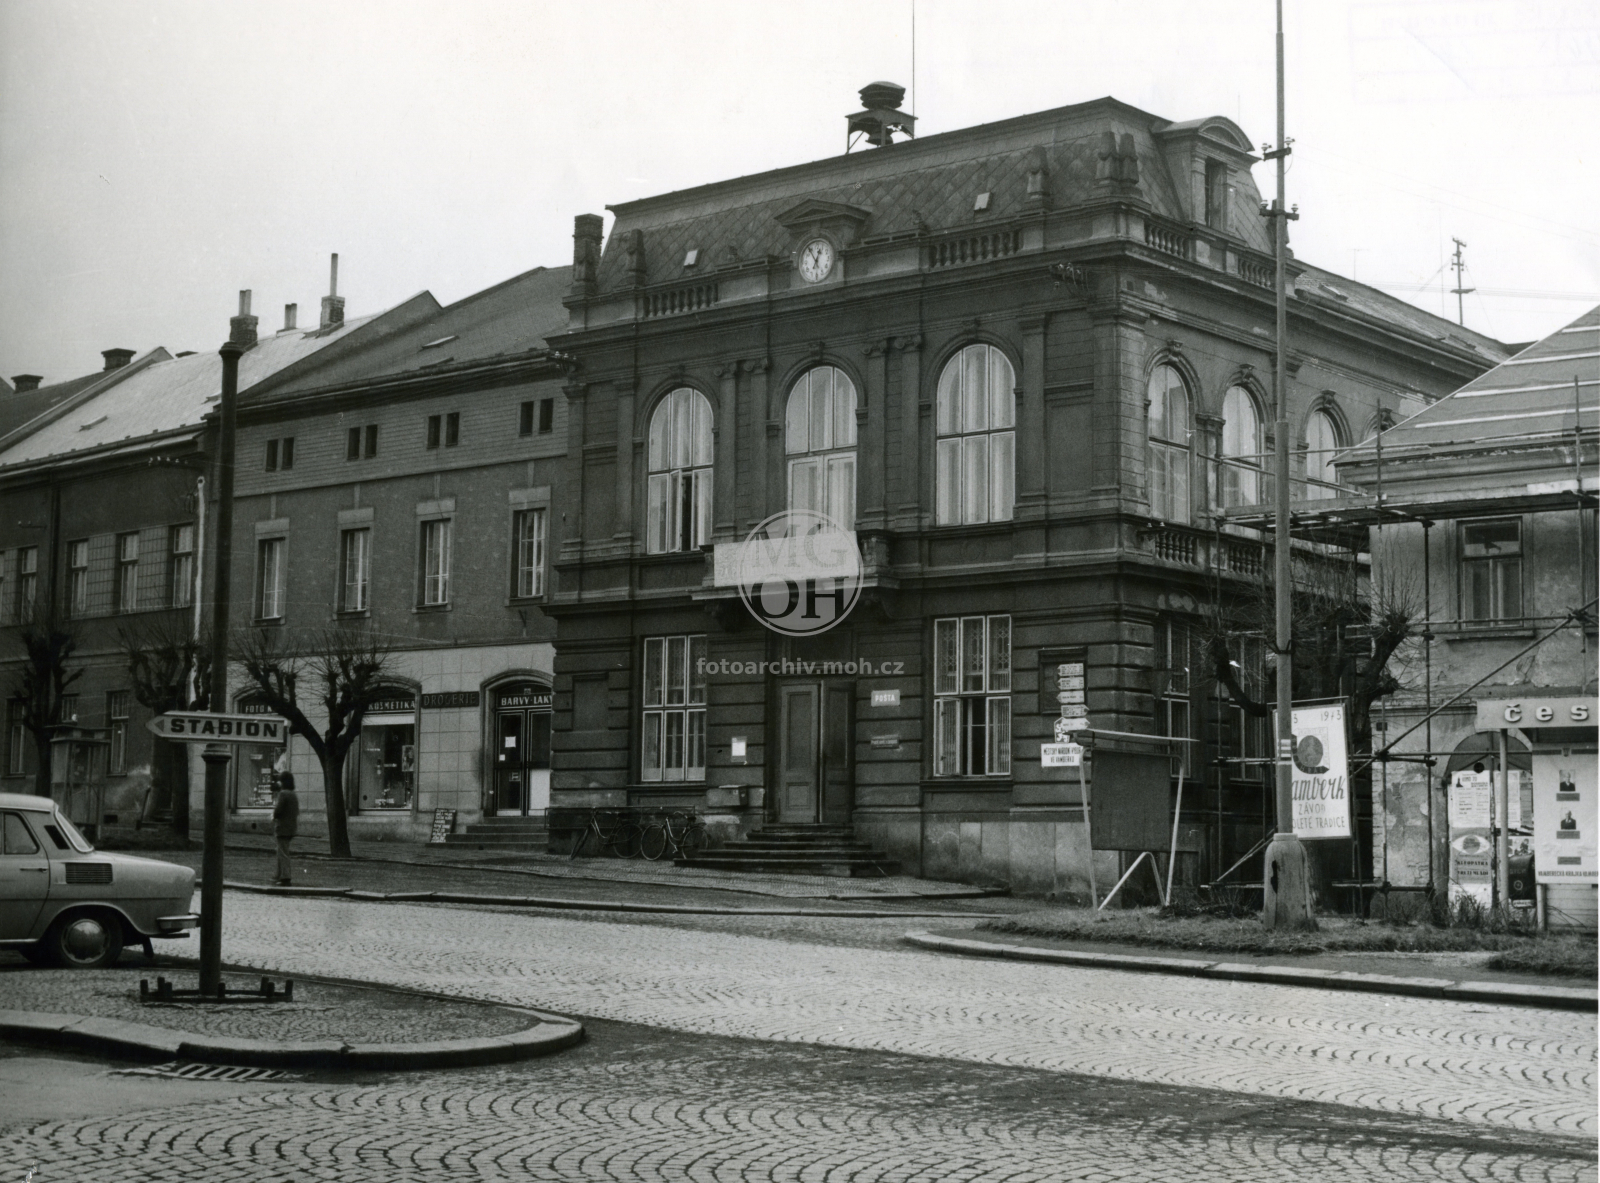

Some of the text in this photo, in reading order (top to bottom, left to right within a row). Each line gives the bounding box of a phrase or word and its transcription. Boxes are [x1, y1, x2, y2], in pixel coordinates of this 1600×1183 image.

[368, 700, 415, 710] KOSMETIKA
[424, 693, 476, 706] DROGERIE
[245, 705, 265, 713] FOTO
[1504, 703, 1590, 722] čes
[171, 718, 278, 738] STADION
[1292, 776, 1346, 801] amberk
[1315, 816, 1345, 829] TRADICE
